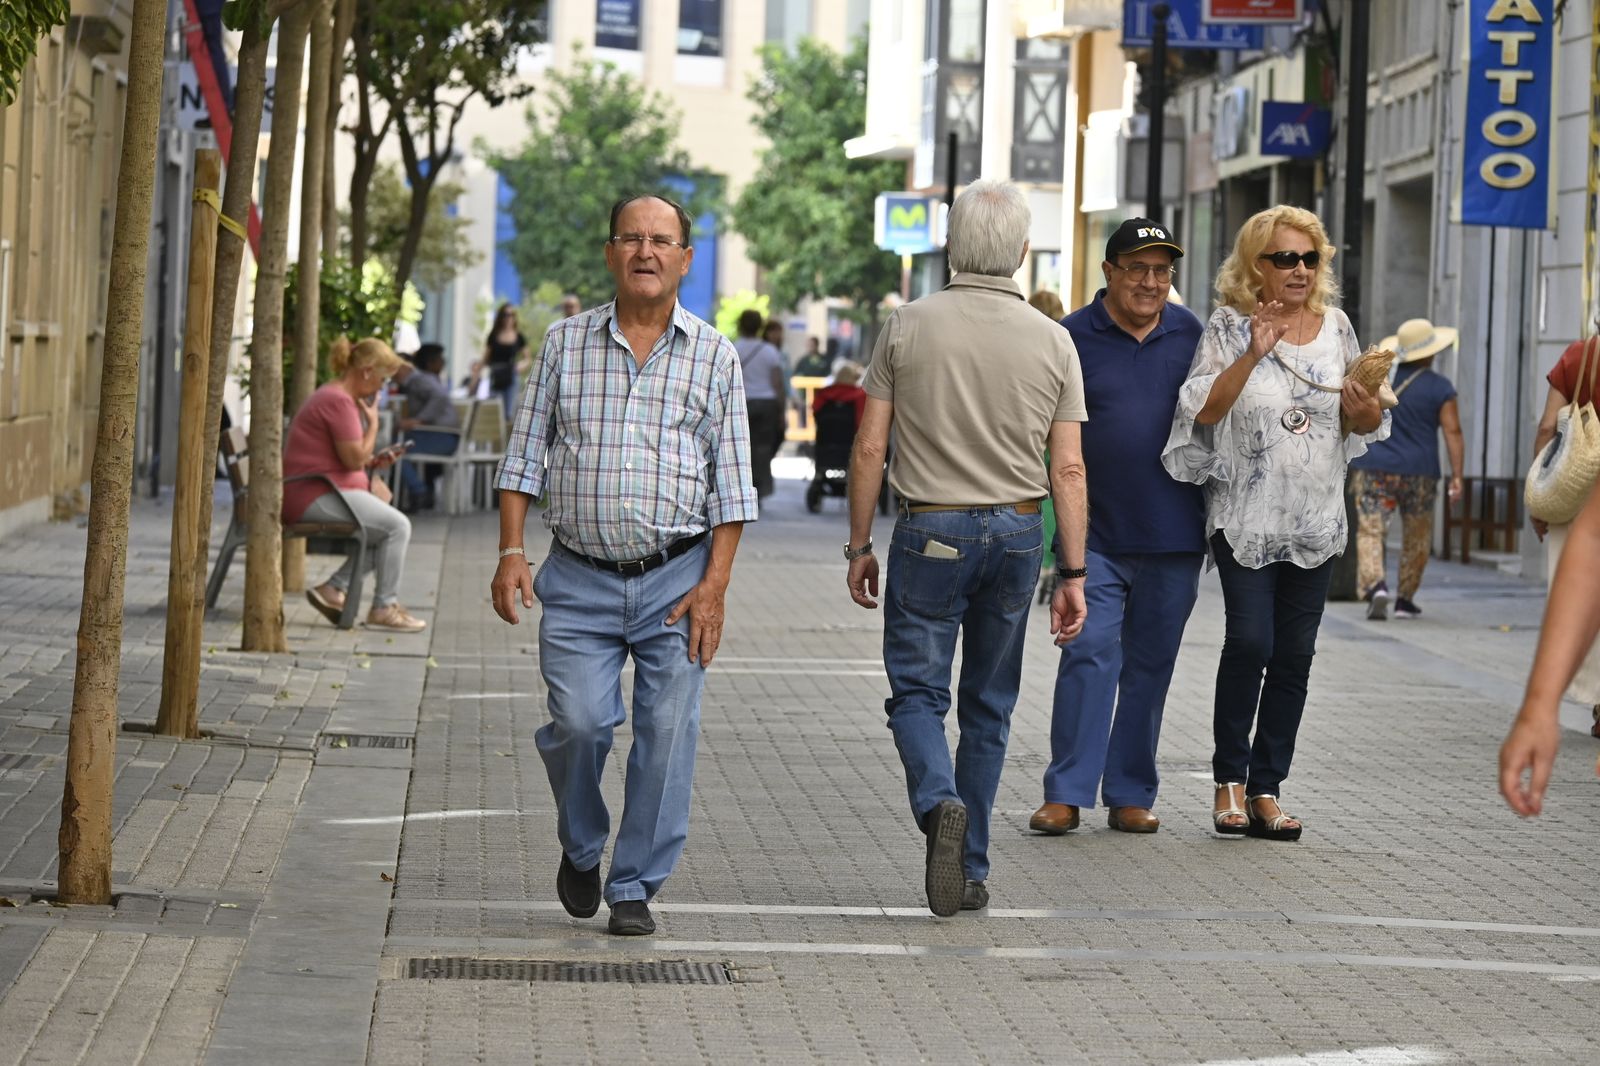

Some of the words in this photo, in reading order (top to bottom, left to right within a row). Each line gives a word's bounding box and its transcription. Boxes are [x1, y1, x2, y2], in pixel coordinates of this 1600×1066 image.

[1480, 0, 1542, 188] ATTOO
[1265, 122, 1311, 146] AXA
[1137, 227, 1166, 239] BYG
